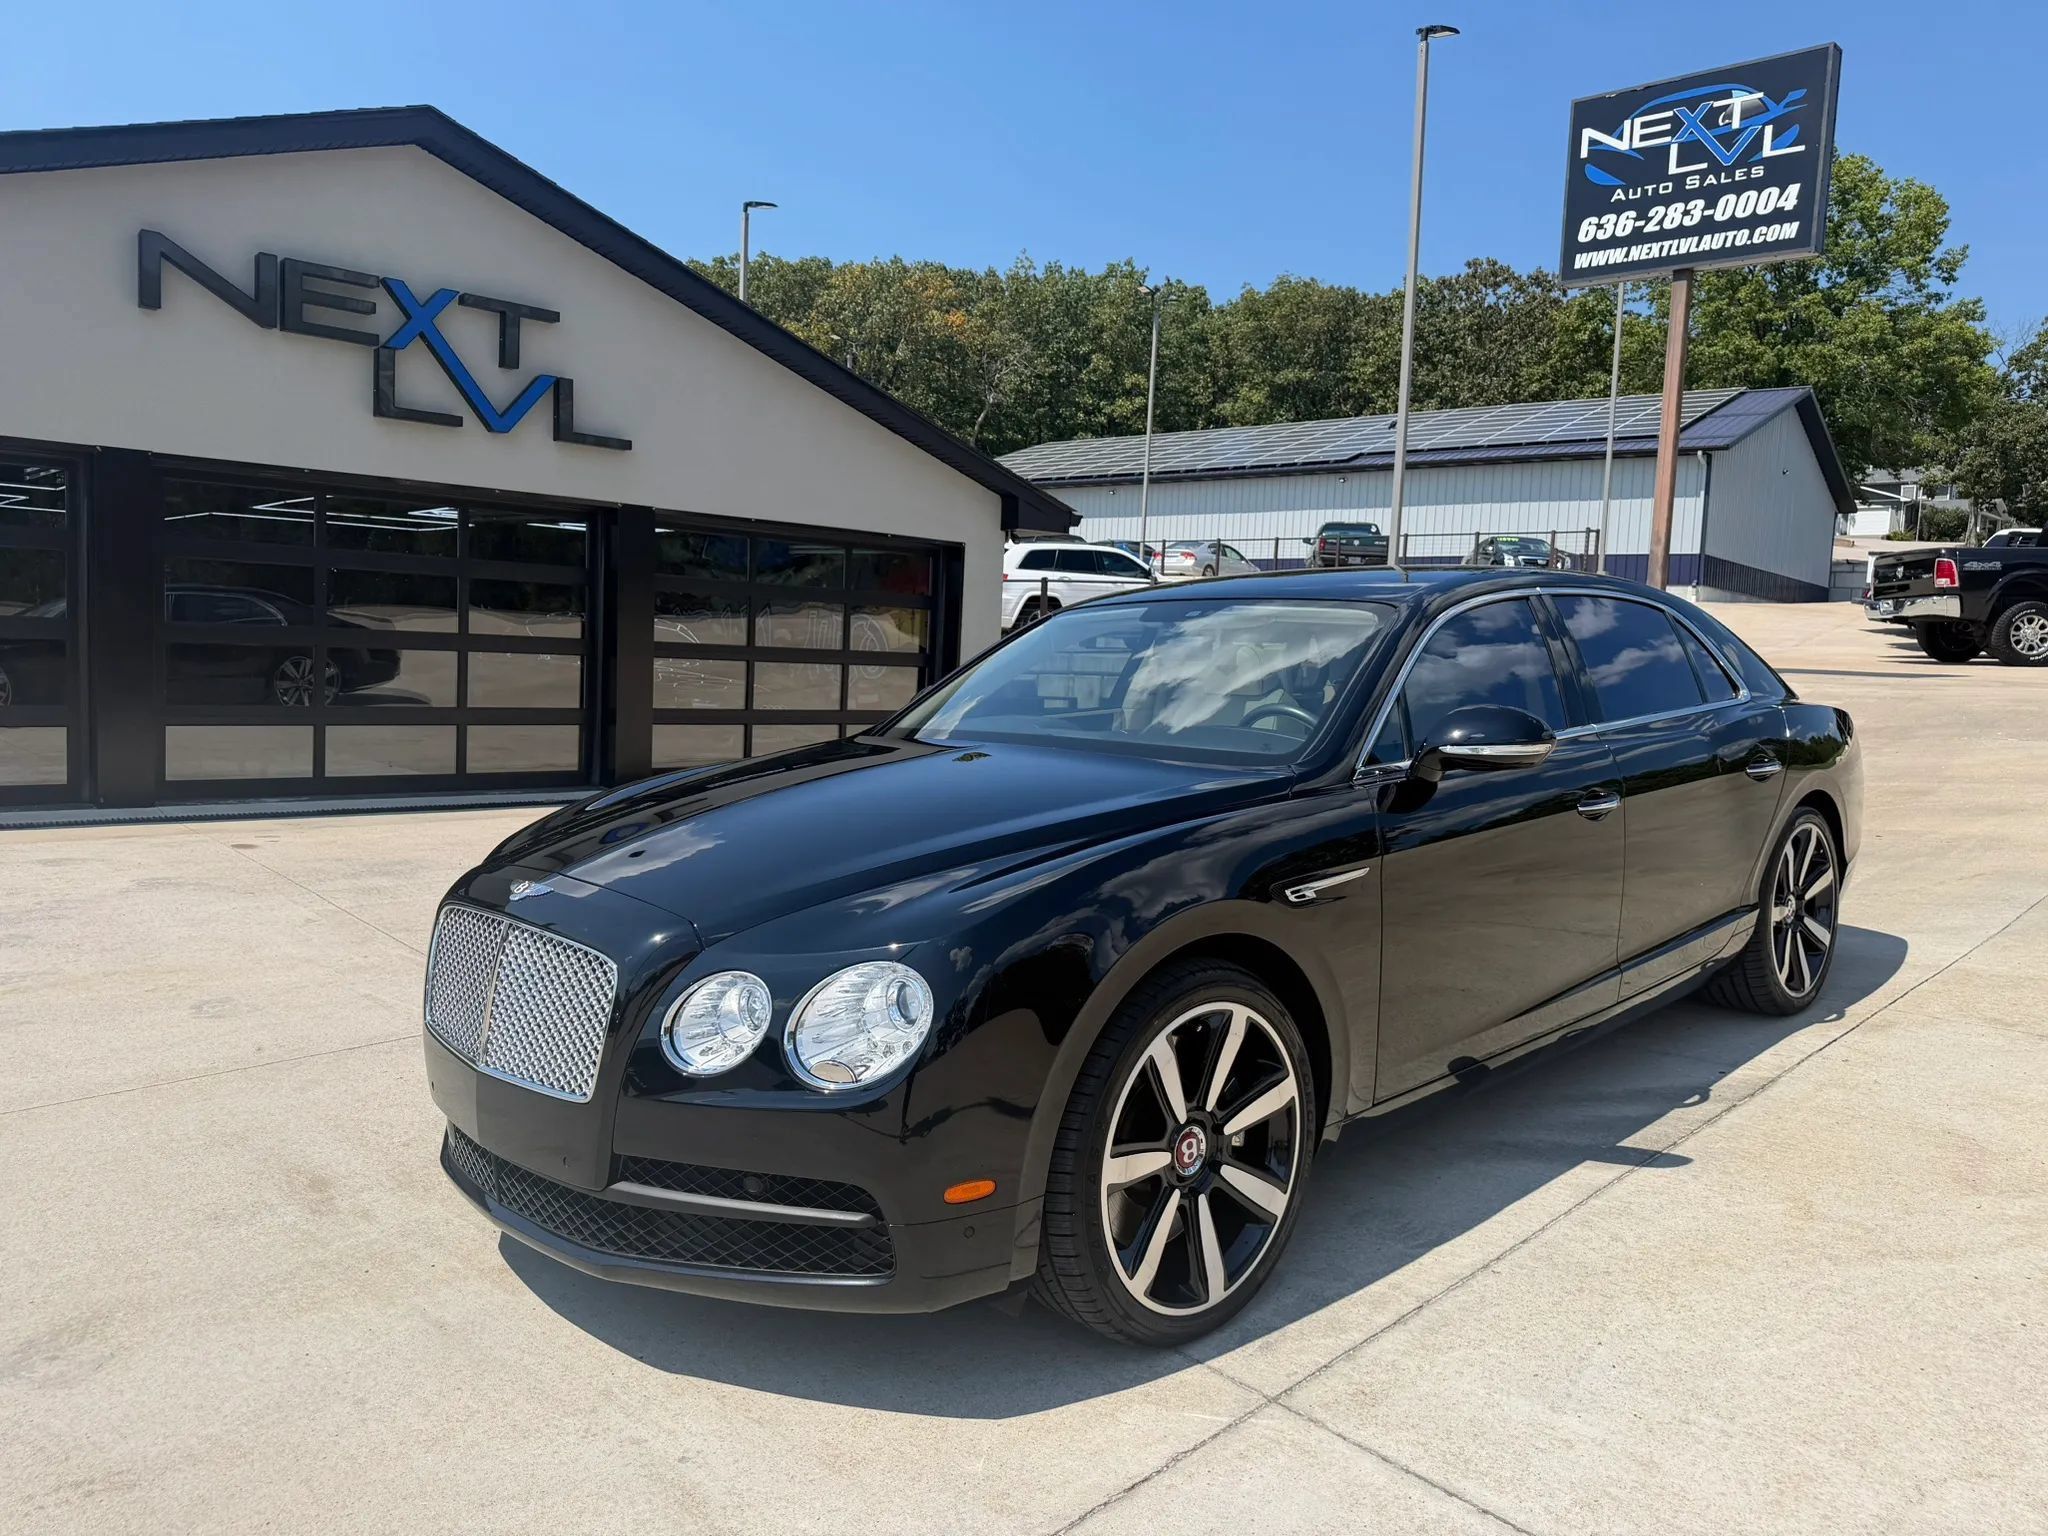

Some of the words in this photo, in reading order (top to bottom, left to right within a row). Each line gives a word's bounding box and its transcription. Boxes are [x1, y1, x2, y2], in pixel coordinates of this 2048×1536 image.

[1580, 91, 1764, 160] NEXT
[1668, 124, 1806, 175] LVL
[1577, 183, 1801, 243] 636-283-0004
[1611, 182, 1673, 203] AUTO
[1685, 165, 1765, 191] SALES
[1574, 221, 1800, 269] WWW.NEXTLVLAUTO.COM
[138, 229, 561, 369] NEXT
[373, 345, 632, 451] LVL
